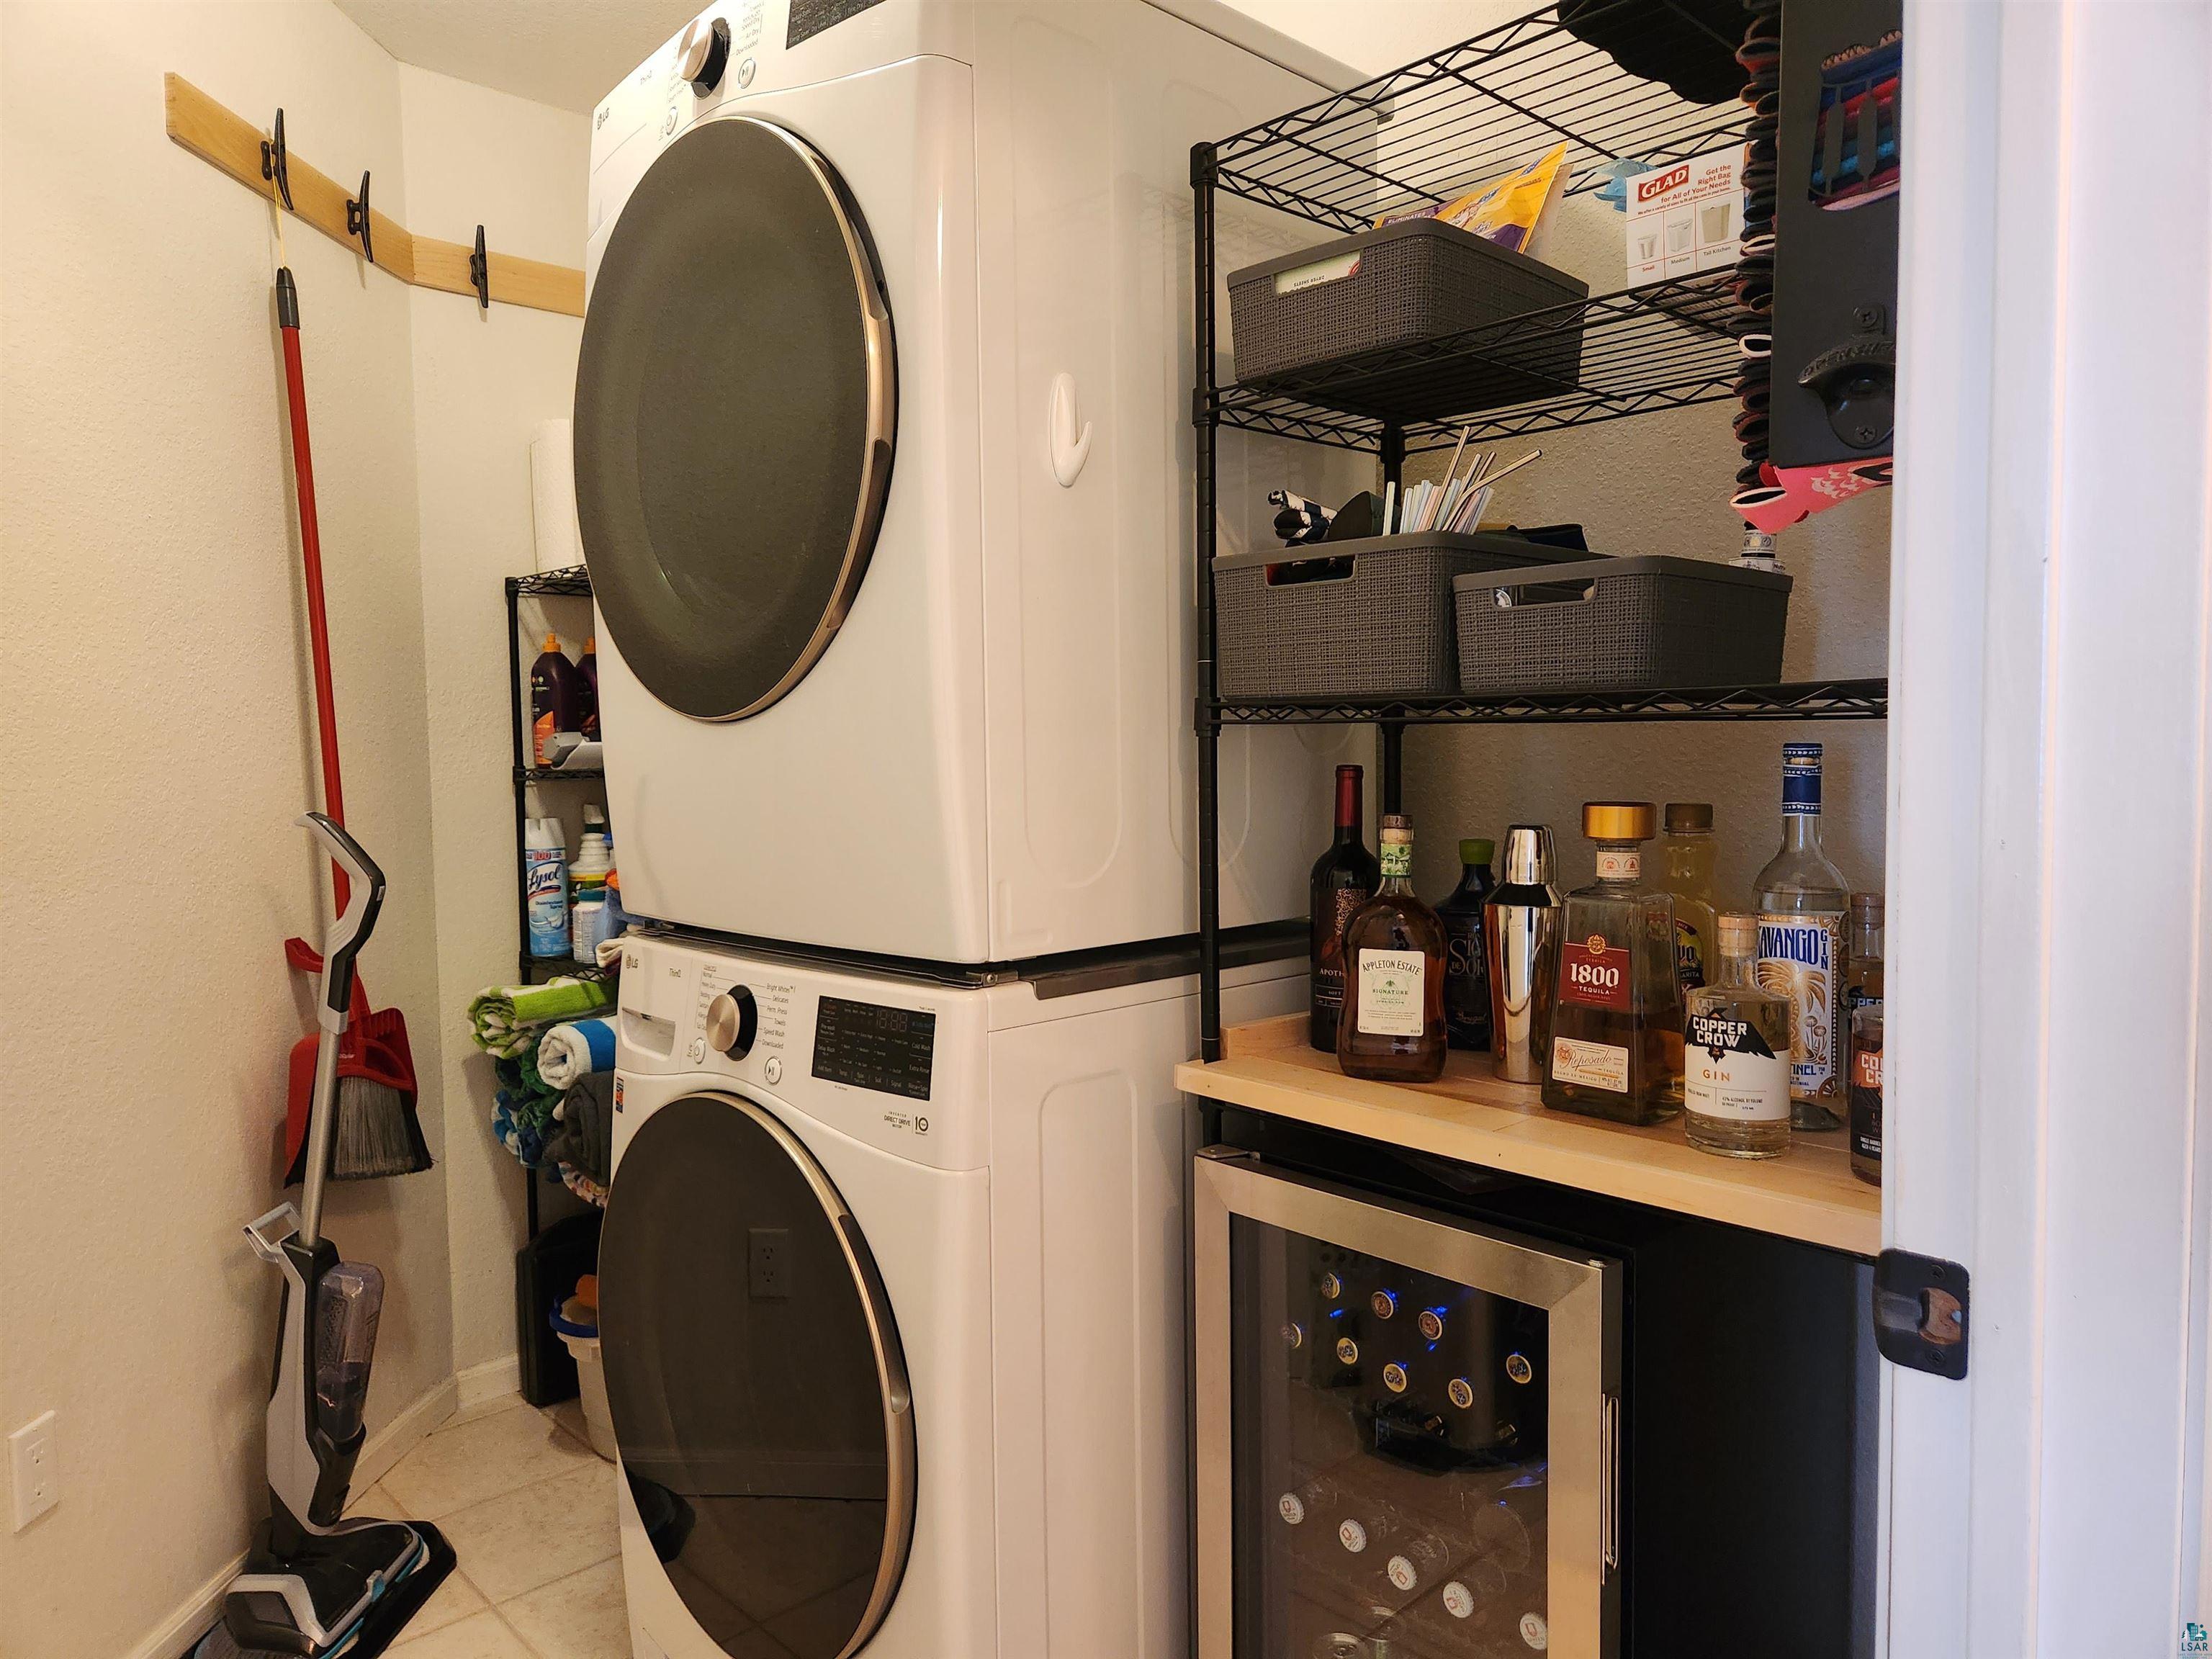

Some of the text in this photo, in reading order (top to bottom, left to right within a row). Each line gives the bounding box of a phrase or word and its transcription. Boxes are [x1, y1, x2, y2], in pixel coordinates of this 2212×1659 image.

[603, 107, 610, 122] LG
[1642, 169, 1687, 198] GLAD
[1698, 171, 1731, 186] Right Bag
[1692, 186, 1707, 194] Your
[1709, 179, 1731, 189] Needs
[1712, 246, 1732, 255] Kitchen
[528, 865, 562, 891] Lysol
[1820, 929, 1829, 971] GIN
[631, 958, 638, 968] LG
[1362, 960, 1395, 973] APPLETON
[670, 968, 681, 978] ThinQ
[1570, 963, 1619, 987] 1800
[1578, 986, 1609, 995] TEQUILA
[773, 995, 789, 1004] Delicates
[763, 1027, 775, 1035] Speed
[1693, 1016, 1747, 1035] COPPER
[762, 1038, 784, 1049] Downloaded
[1696, 1030, 1740, 1048] CROW
[1560, 1049, 1611, 1071] Reposado
[1703, 1069, 1730, 1082] GIN
[884, 1115, 898, 1123] DIRECT
[915, 1116, 929, 1131] 10
